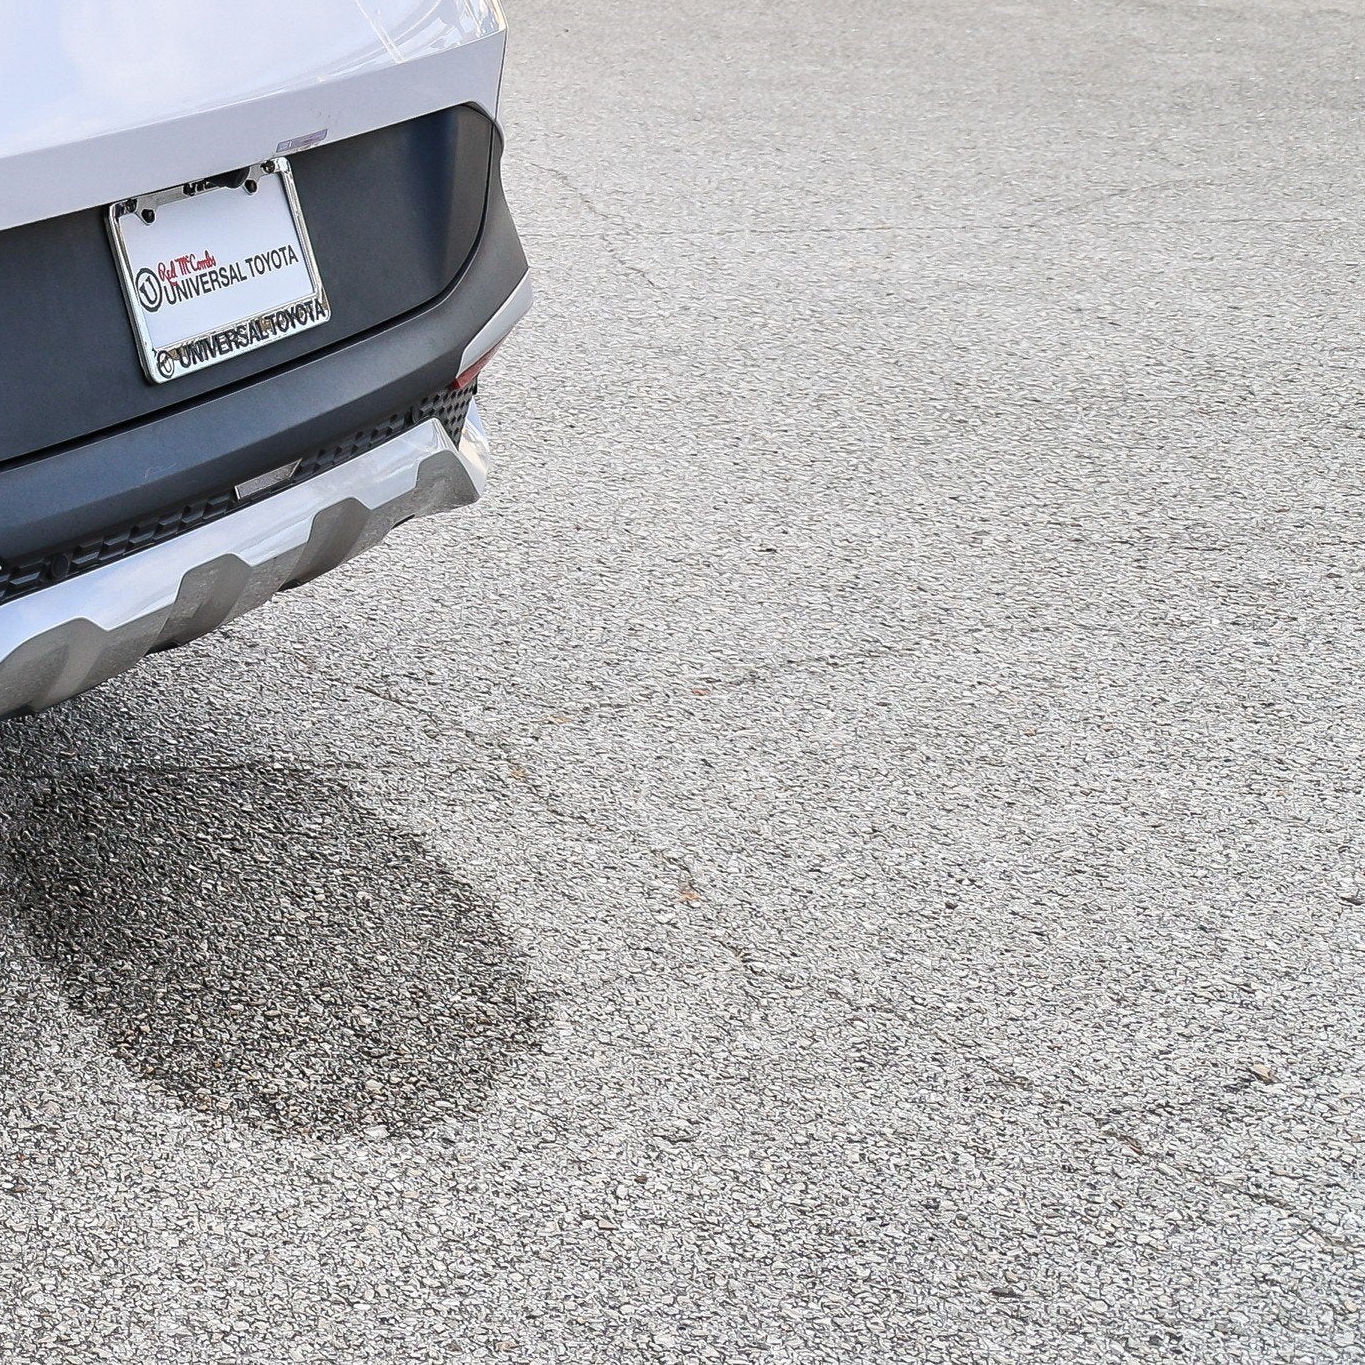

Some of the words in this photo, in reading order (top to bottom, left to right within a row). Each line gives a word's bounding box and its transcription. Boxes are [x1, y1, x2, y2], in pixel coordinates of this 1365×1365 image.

[158, 261, 178, 286] Red
[163, 262, 247, 305] UNIVERSAL
[245, 245, 299, 278] TOYOTA
[178, 319, 270, 368] UNIVERSAL
[269, 298, 327, 335] TOYOTA
